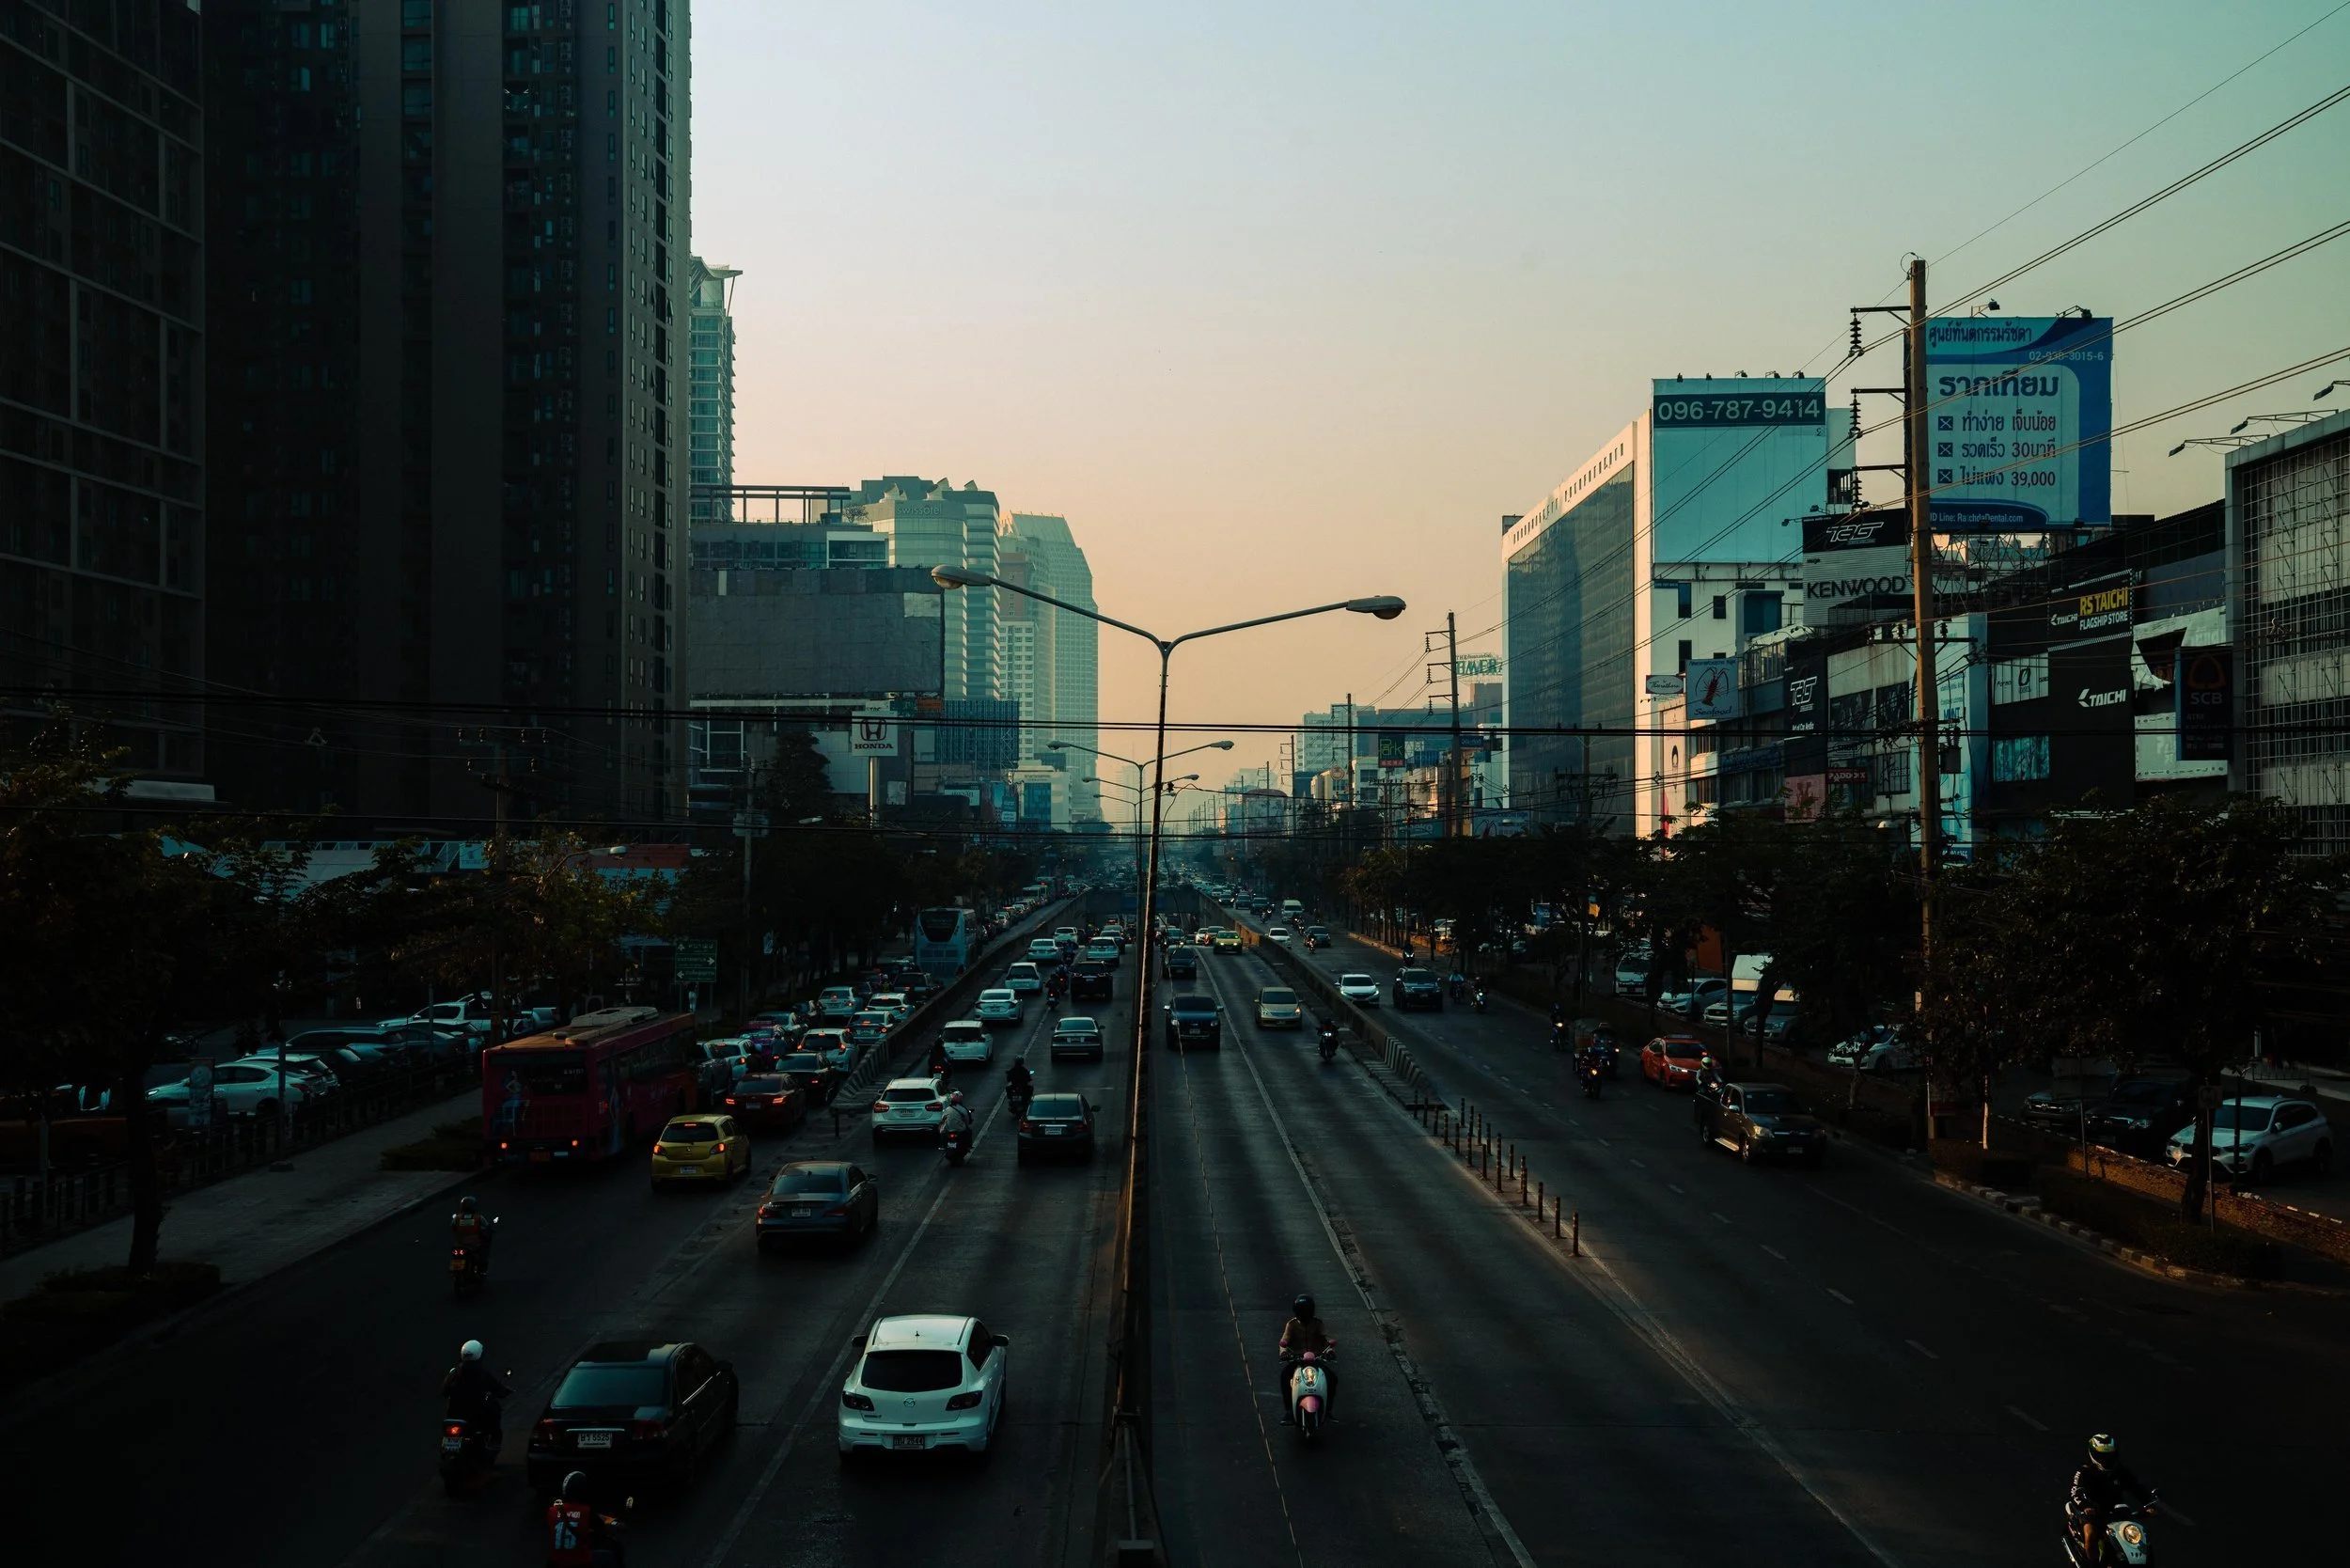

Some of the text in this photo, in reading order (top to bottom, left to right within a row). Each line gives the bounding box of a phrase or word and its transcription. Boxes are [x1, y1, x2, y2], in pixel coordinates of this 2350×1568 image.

[1939, 368, 2060, 397] รากเทียม
[1657, 399, 1821, 421] 096-787-9414
[1962, 408, 2057, 431] ทำง่าย เจ็บน้อย
[1962, 436, 2006, 458] รวดเร็ว
[2011, 471, 2056, 488] 39,000
[1807, 576, 1906, 599] KENWOOD
[2079, 587, 2129, 616] RS TAICHI
[2079, 610, 2129, 632] FLAGSHIP STORE
[2089, 689, 2127, 707] TAICHI
[2189, 692, 2223, 705] SCB
[1693, 706, 1732, 717] Seafood
